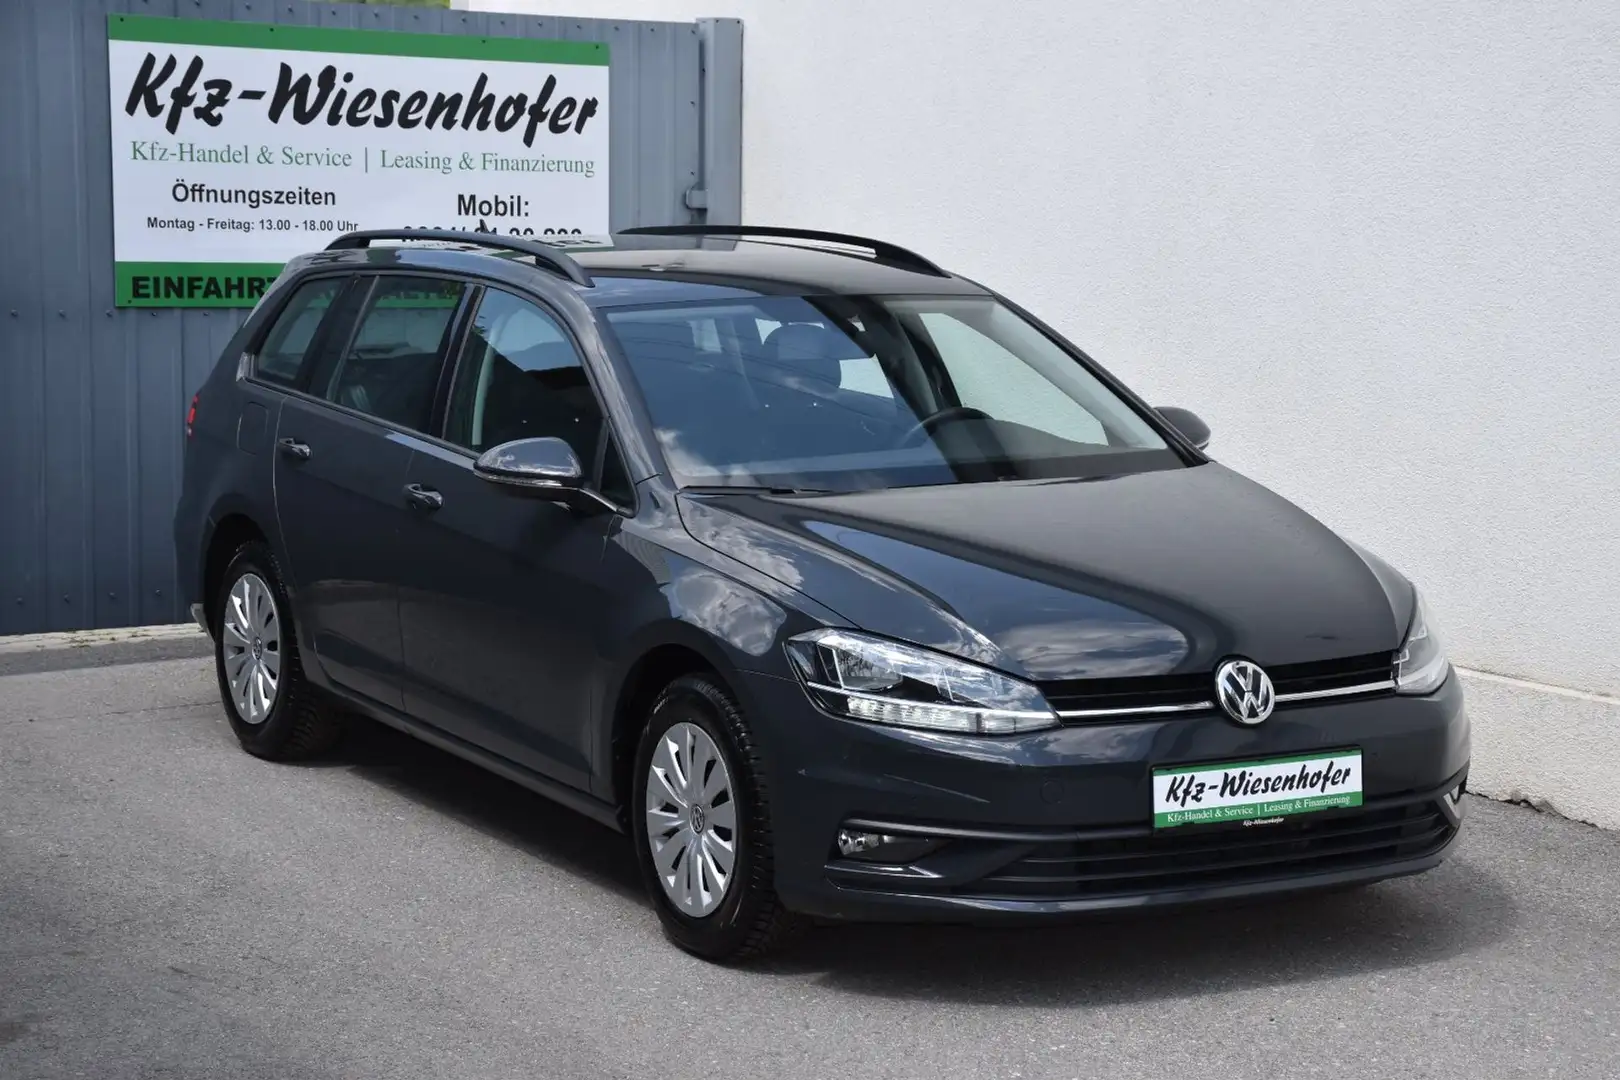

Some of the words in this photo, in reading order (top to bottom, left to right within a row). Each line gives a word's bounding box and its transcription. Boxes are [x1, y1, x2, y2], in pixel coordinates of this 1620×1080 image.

[125, 51, 600, 148] Kfz-Wiesenhofer
[130, 140, 249, 164] Kfz-Handel
[256, 145, 275, 165] &
[281, 145, 353, 167] Service
[380, 149, 452, 175] Leasing
[458, 151, 476, 171] &
[481, 152, 595, 178] Finanzierung
[172, 178, 336, 209] Öffnungszeiten
[457, 193, 530, 217] Mobil:
[147, 217, 195, 232] Montag
[207, 218, 255, 233] Freitag:
[259, 219, 291, 231] 13.00
[303, 220, 334, 232] 18.00
[337, 220, 358, 232] Uhr
[1165, 760, 1351, 808] Kfz-Wiesenhofer
[1167, 809, 1213, 823] Kfz-Handel
[1215, 807, 1222, 818] &
[1224, 805, 1254, 817] Service
[1264, 801, 1293, 813] Leasing
[1295, 799, 1302, 809] &
[1304, 795, 1351, 809] Finanzierung
